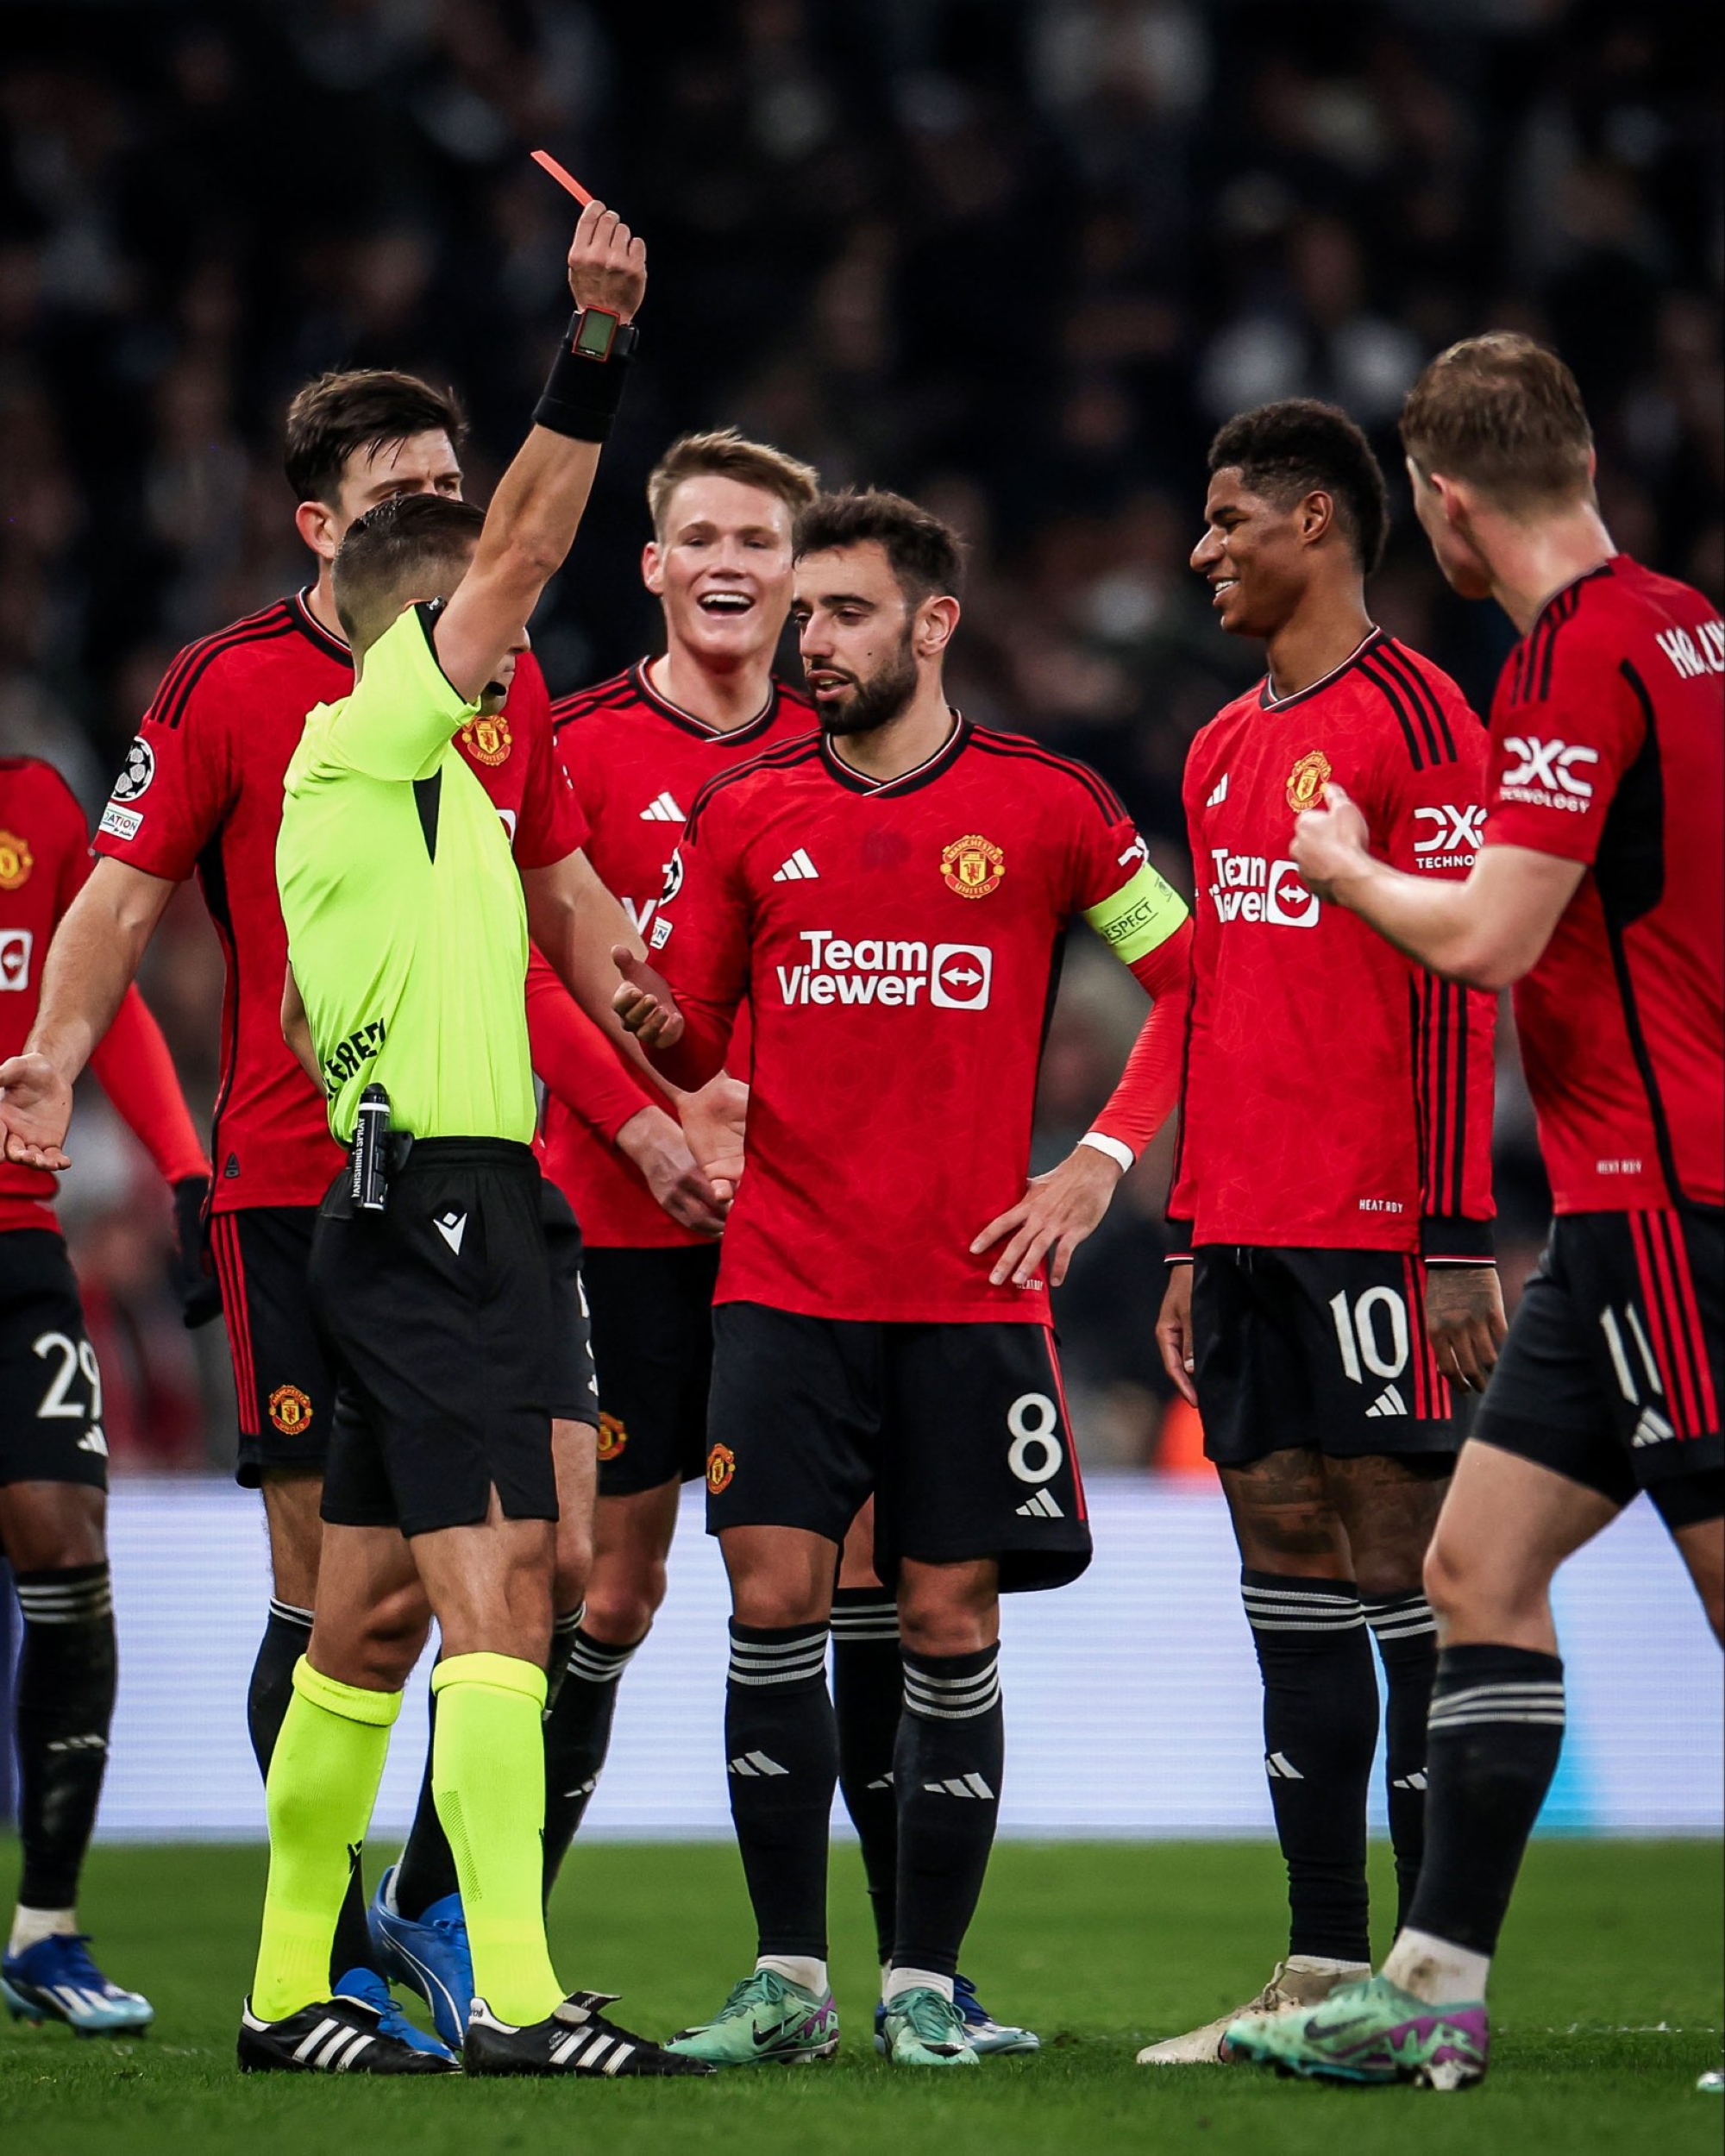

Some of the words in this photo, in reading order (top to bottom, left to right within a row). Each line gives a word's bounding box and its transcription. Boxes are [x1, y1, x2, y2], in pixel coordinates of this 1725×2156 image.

[1502, 736, 1599, 798] DXC
[1415, 855, 1476, 869] TECHNO
[800, 930, 927, 971] Team
[1103, 901, 1152, 941] ESPECT
[776, 965, 926, 1005] Viewer
[1329, 1285, 1409, 1384] 10
[1600, 1302, 1663, 1405] 11
[33, 1332, 102, 1419] 29
[1007, 1392, 1063, 1483] 8
